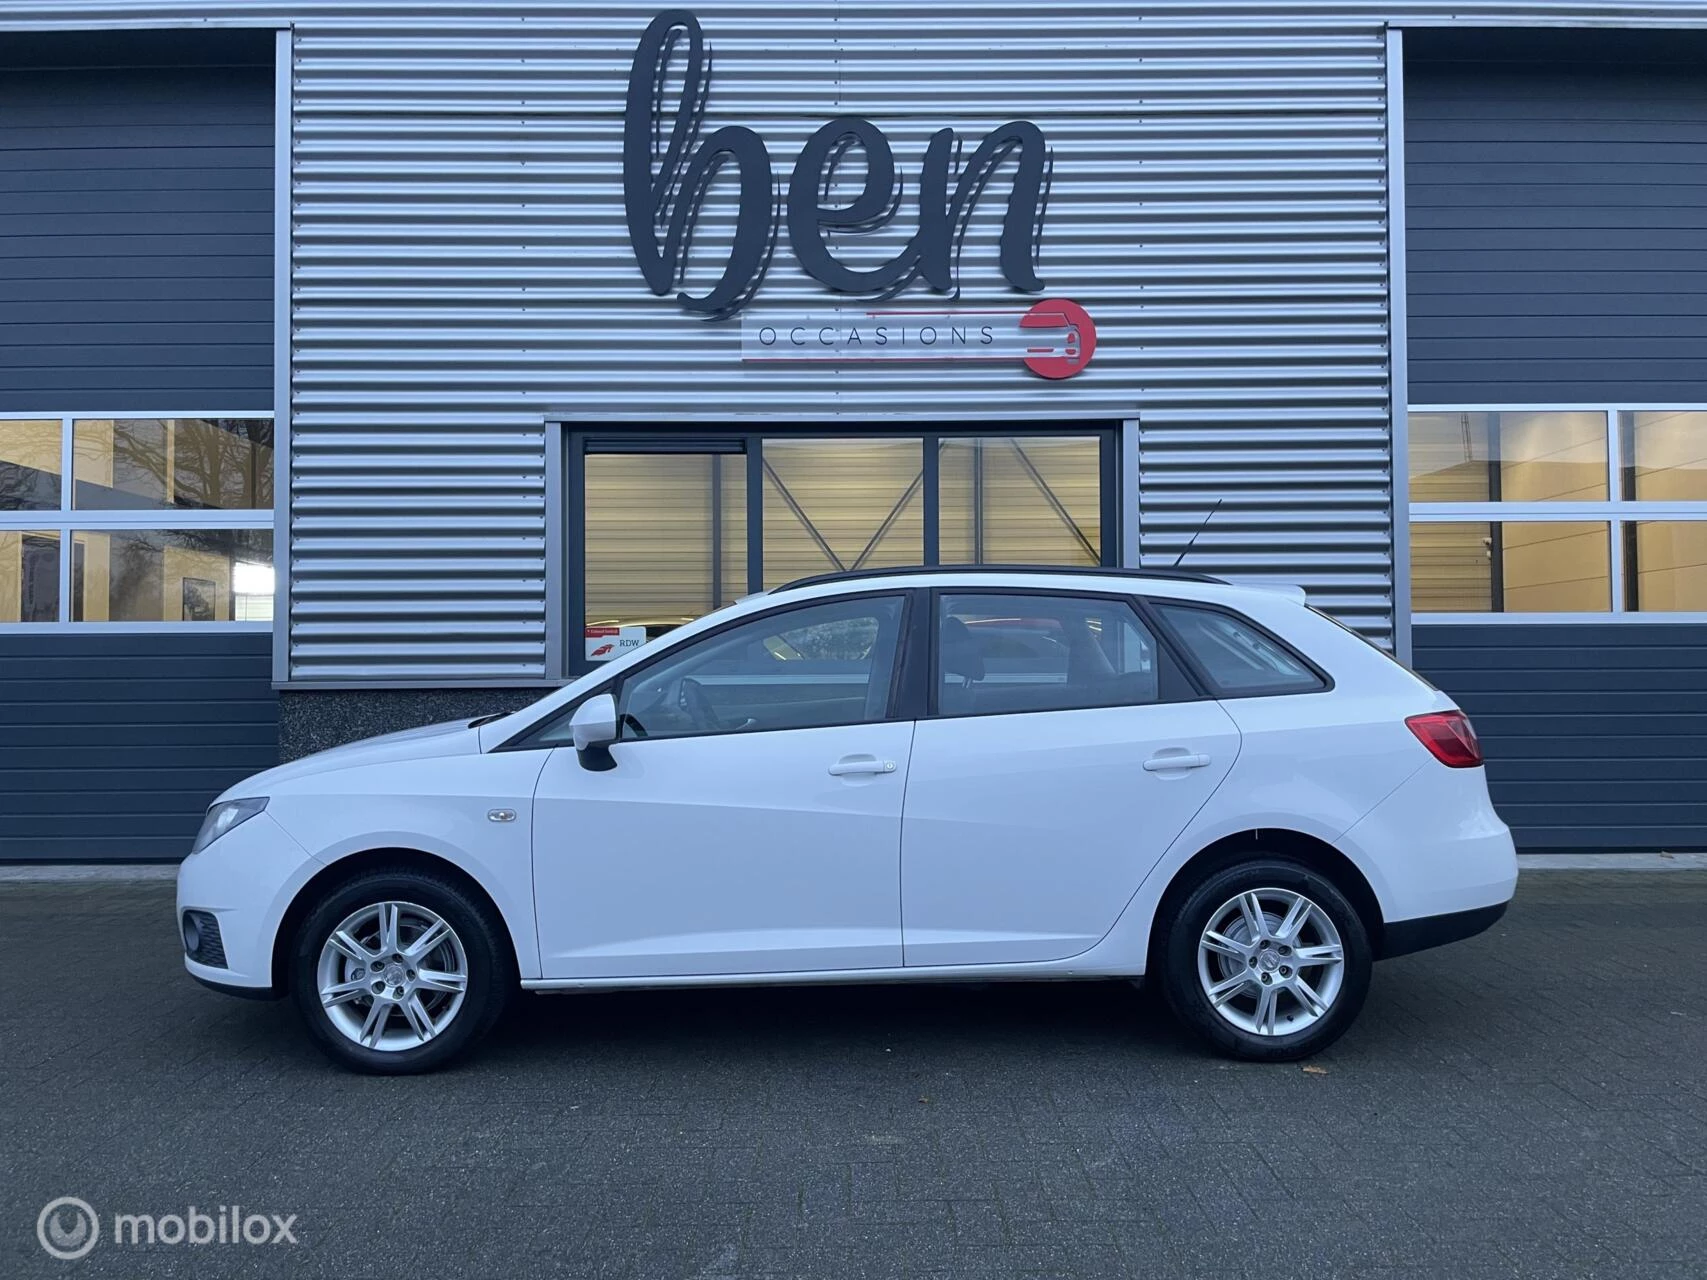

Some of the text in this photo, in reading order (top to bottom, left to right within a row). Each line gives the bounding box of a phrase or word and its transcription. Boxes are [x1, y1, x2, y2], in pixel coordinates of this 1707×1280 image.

[623, 9, 1055, 320] ben
[758, 325, 994, 347] OCCASIONS
[619, 639, 640, 647] RDW
